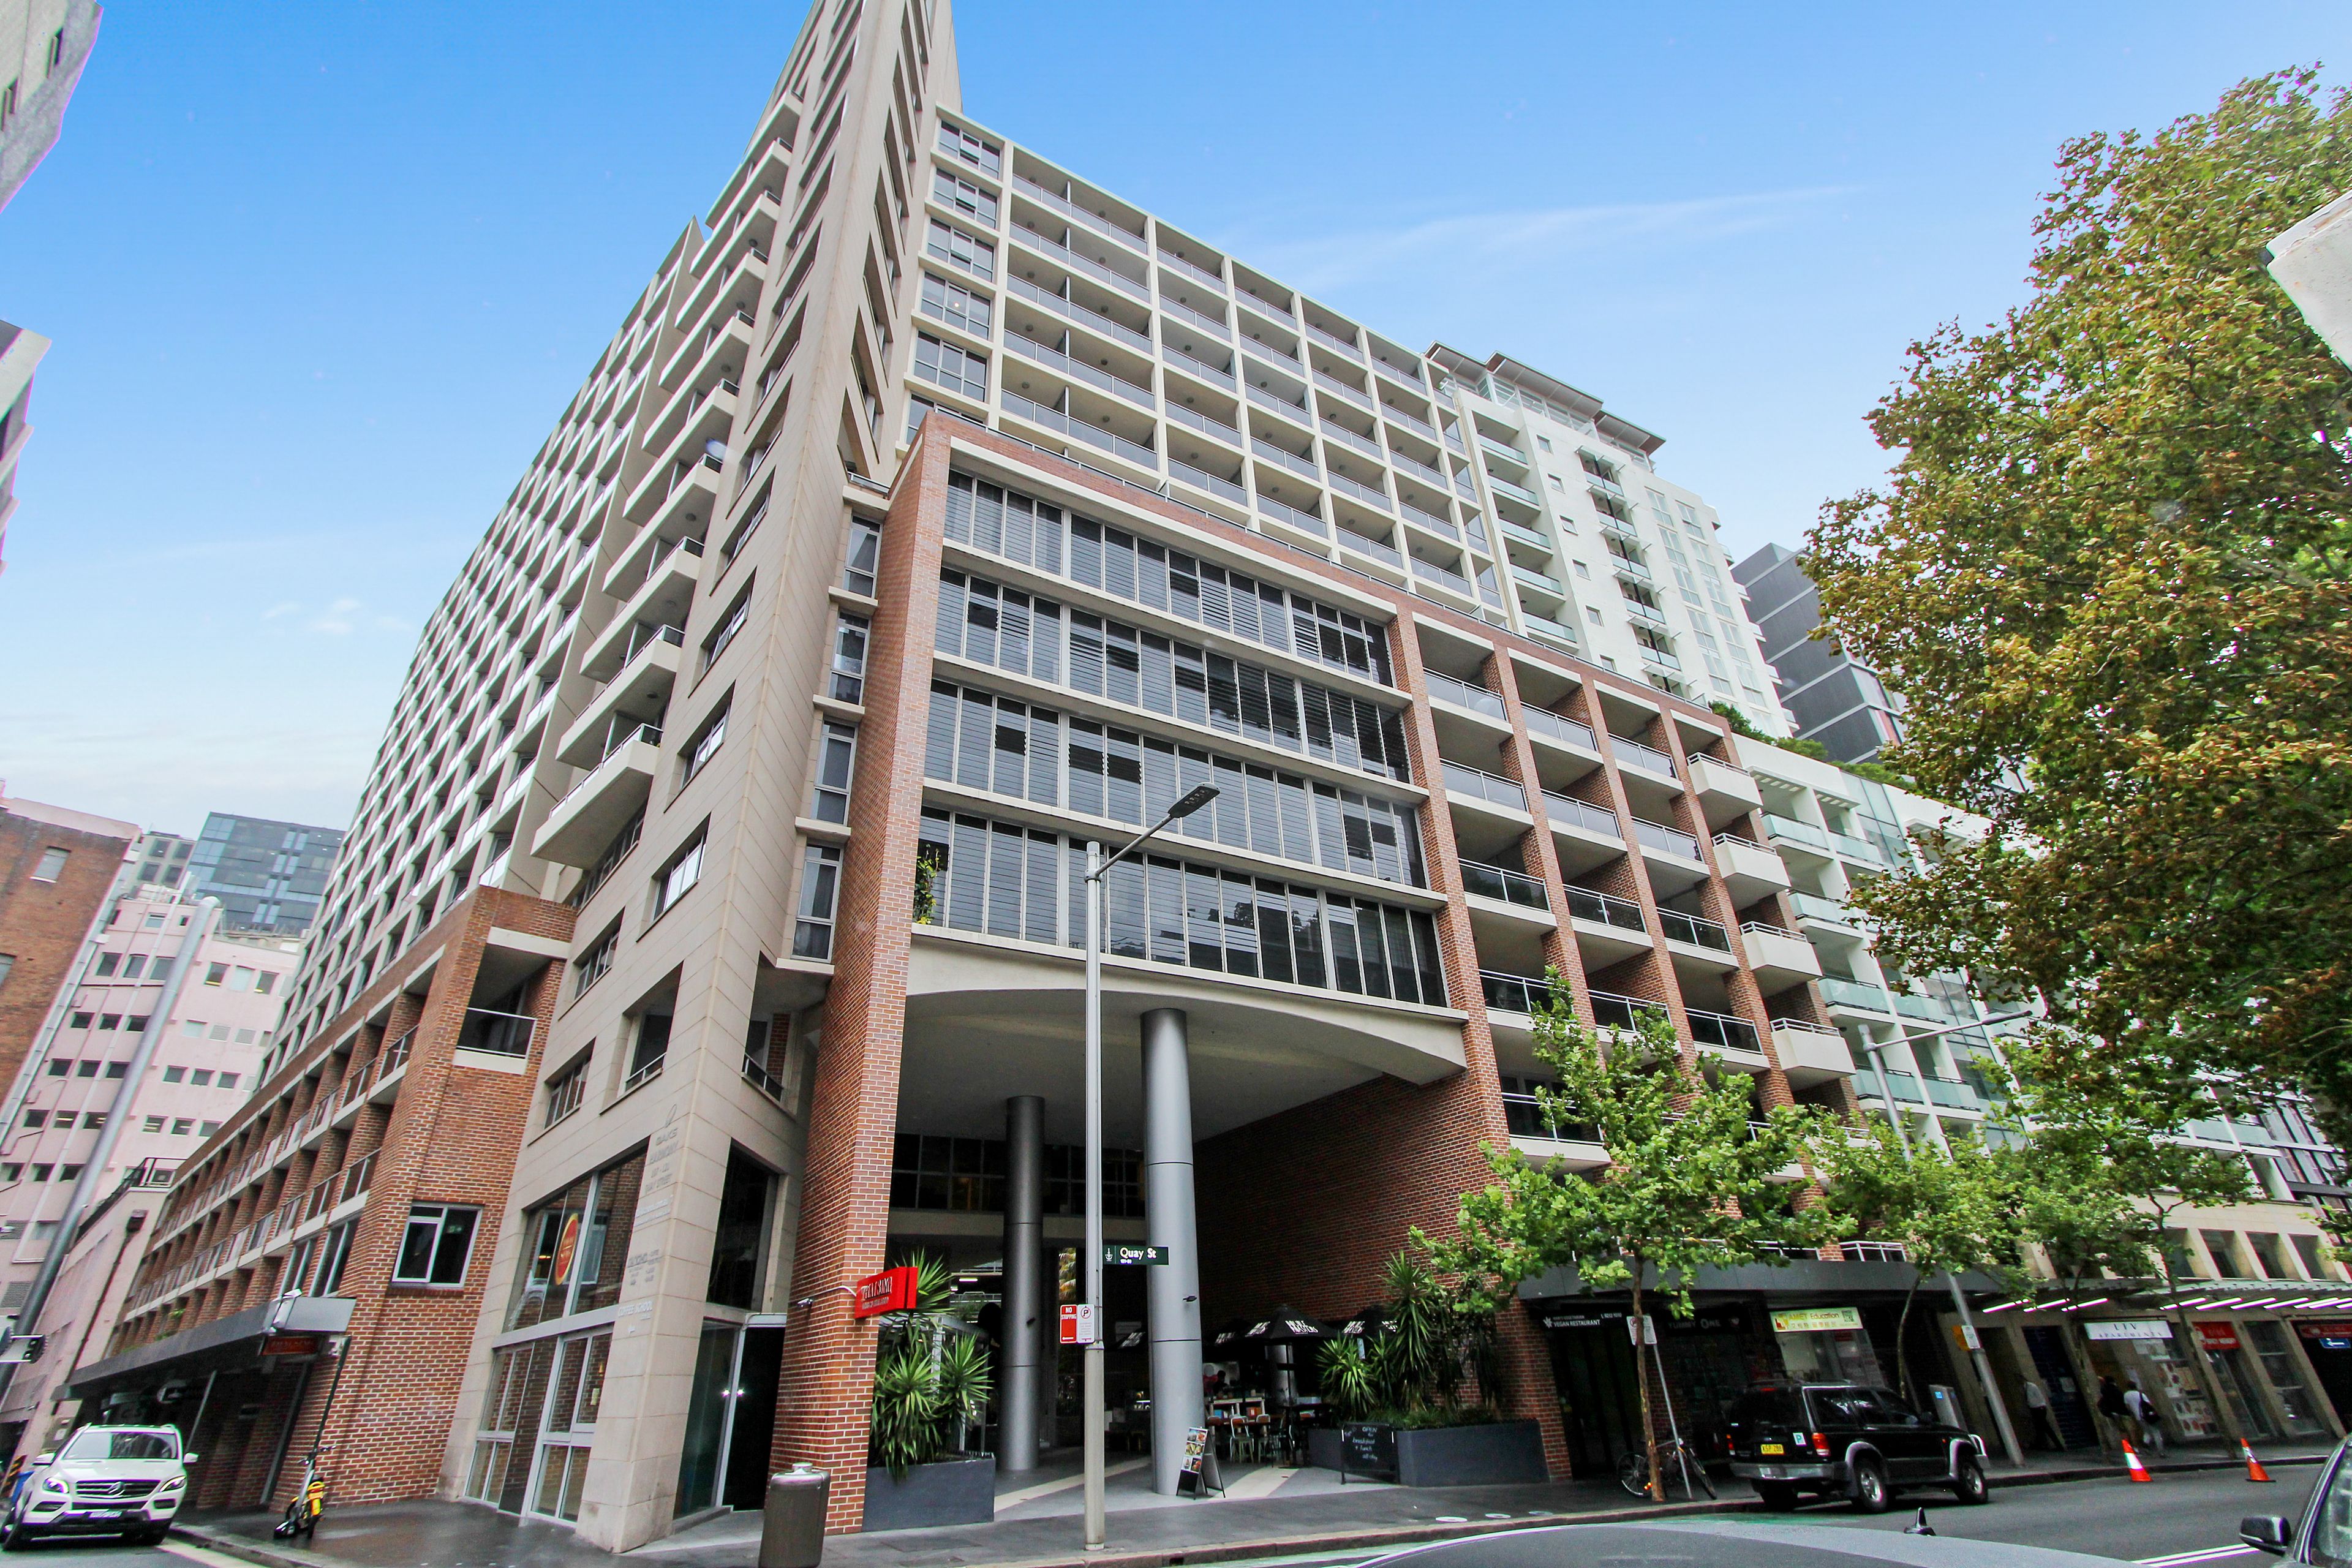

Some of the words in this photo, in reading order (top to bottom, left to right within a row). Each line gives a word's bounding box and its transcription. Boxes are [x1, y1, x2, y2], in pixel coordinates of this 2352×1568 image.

[1120, 1247, 1144, 1260] Quay
[1147, 1248, 1156, 1258] St
[636, 1300, 652, 1313] SCHOOL
[1796, 1434, 1802, 1443] P
